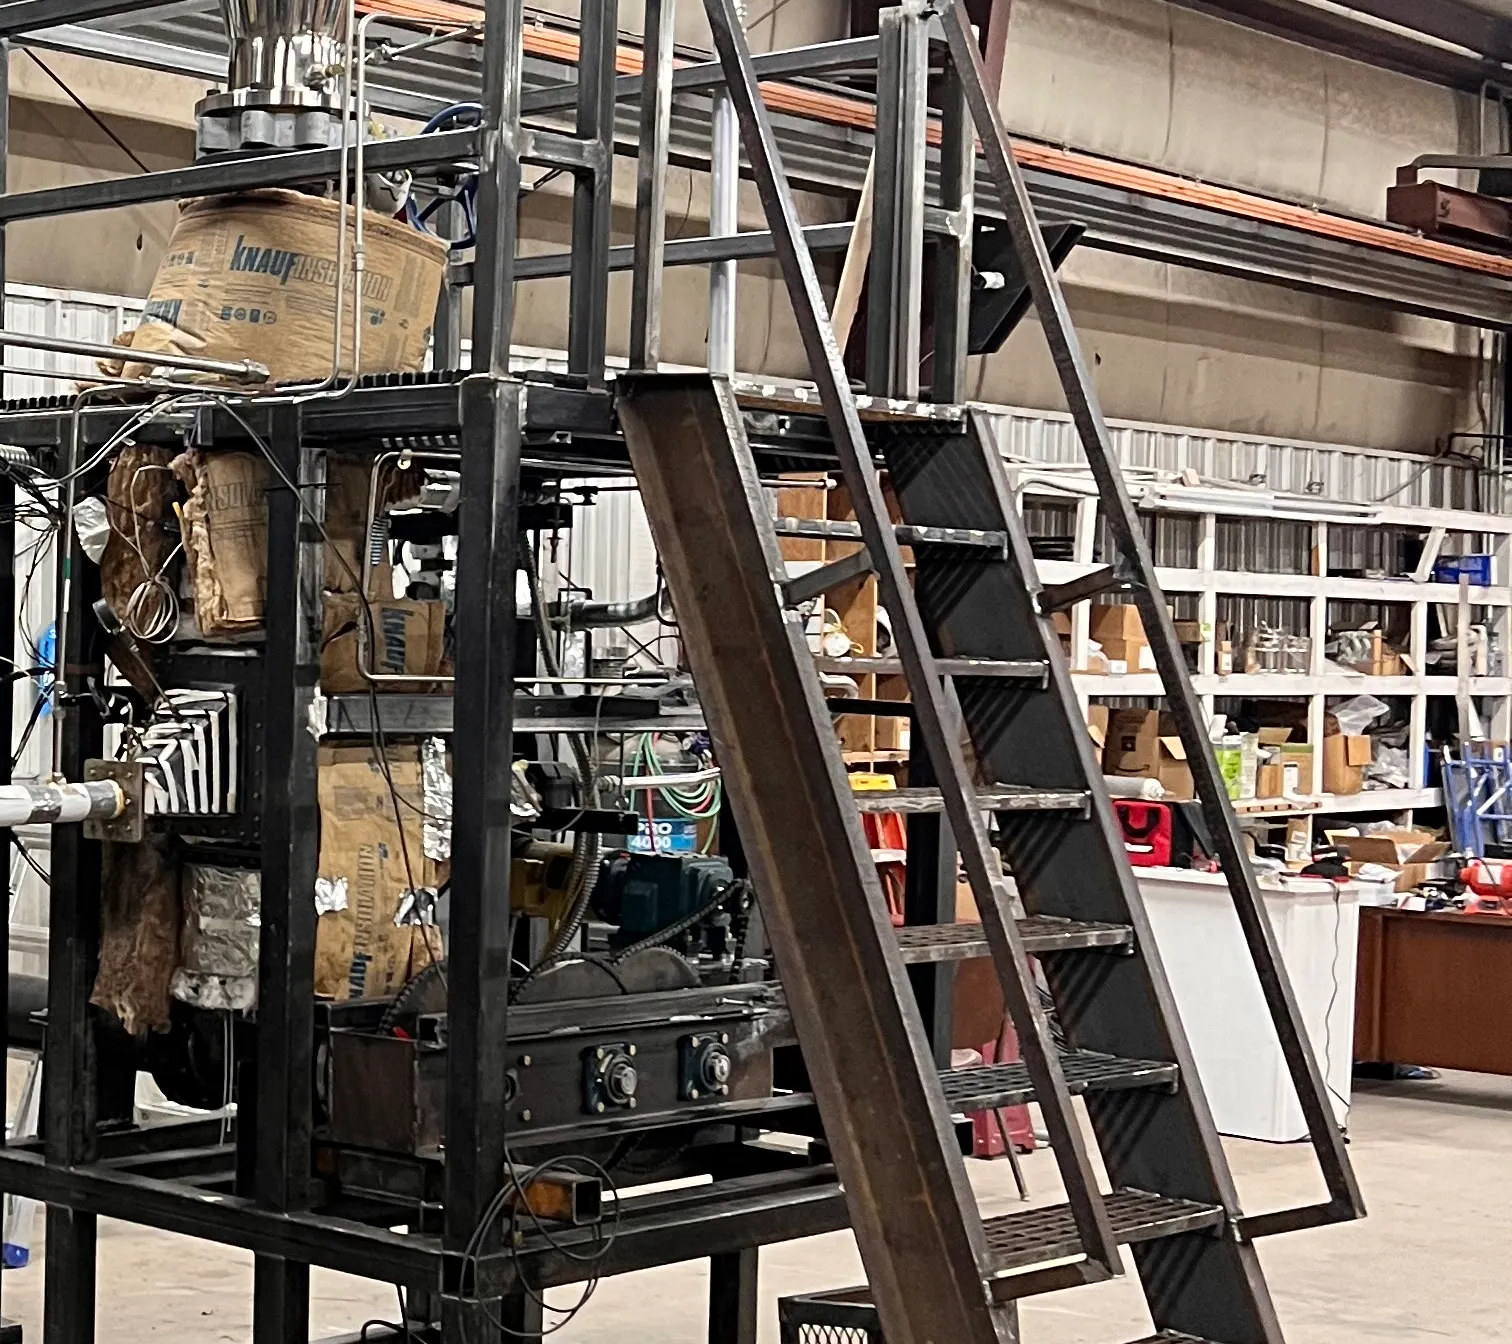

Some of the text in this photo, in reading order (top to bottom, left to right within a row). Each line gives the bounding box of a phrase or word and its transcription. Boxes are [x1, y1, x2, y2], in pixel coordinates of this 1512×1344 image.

[230, 234, 299, 286] KNAUF
[631, 836, 672, 849] 4000
[348, 951, 373, 998] NAUF
